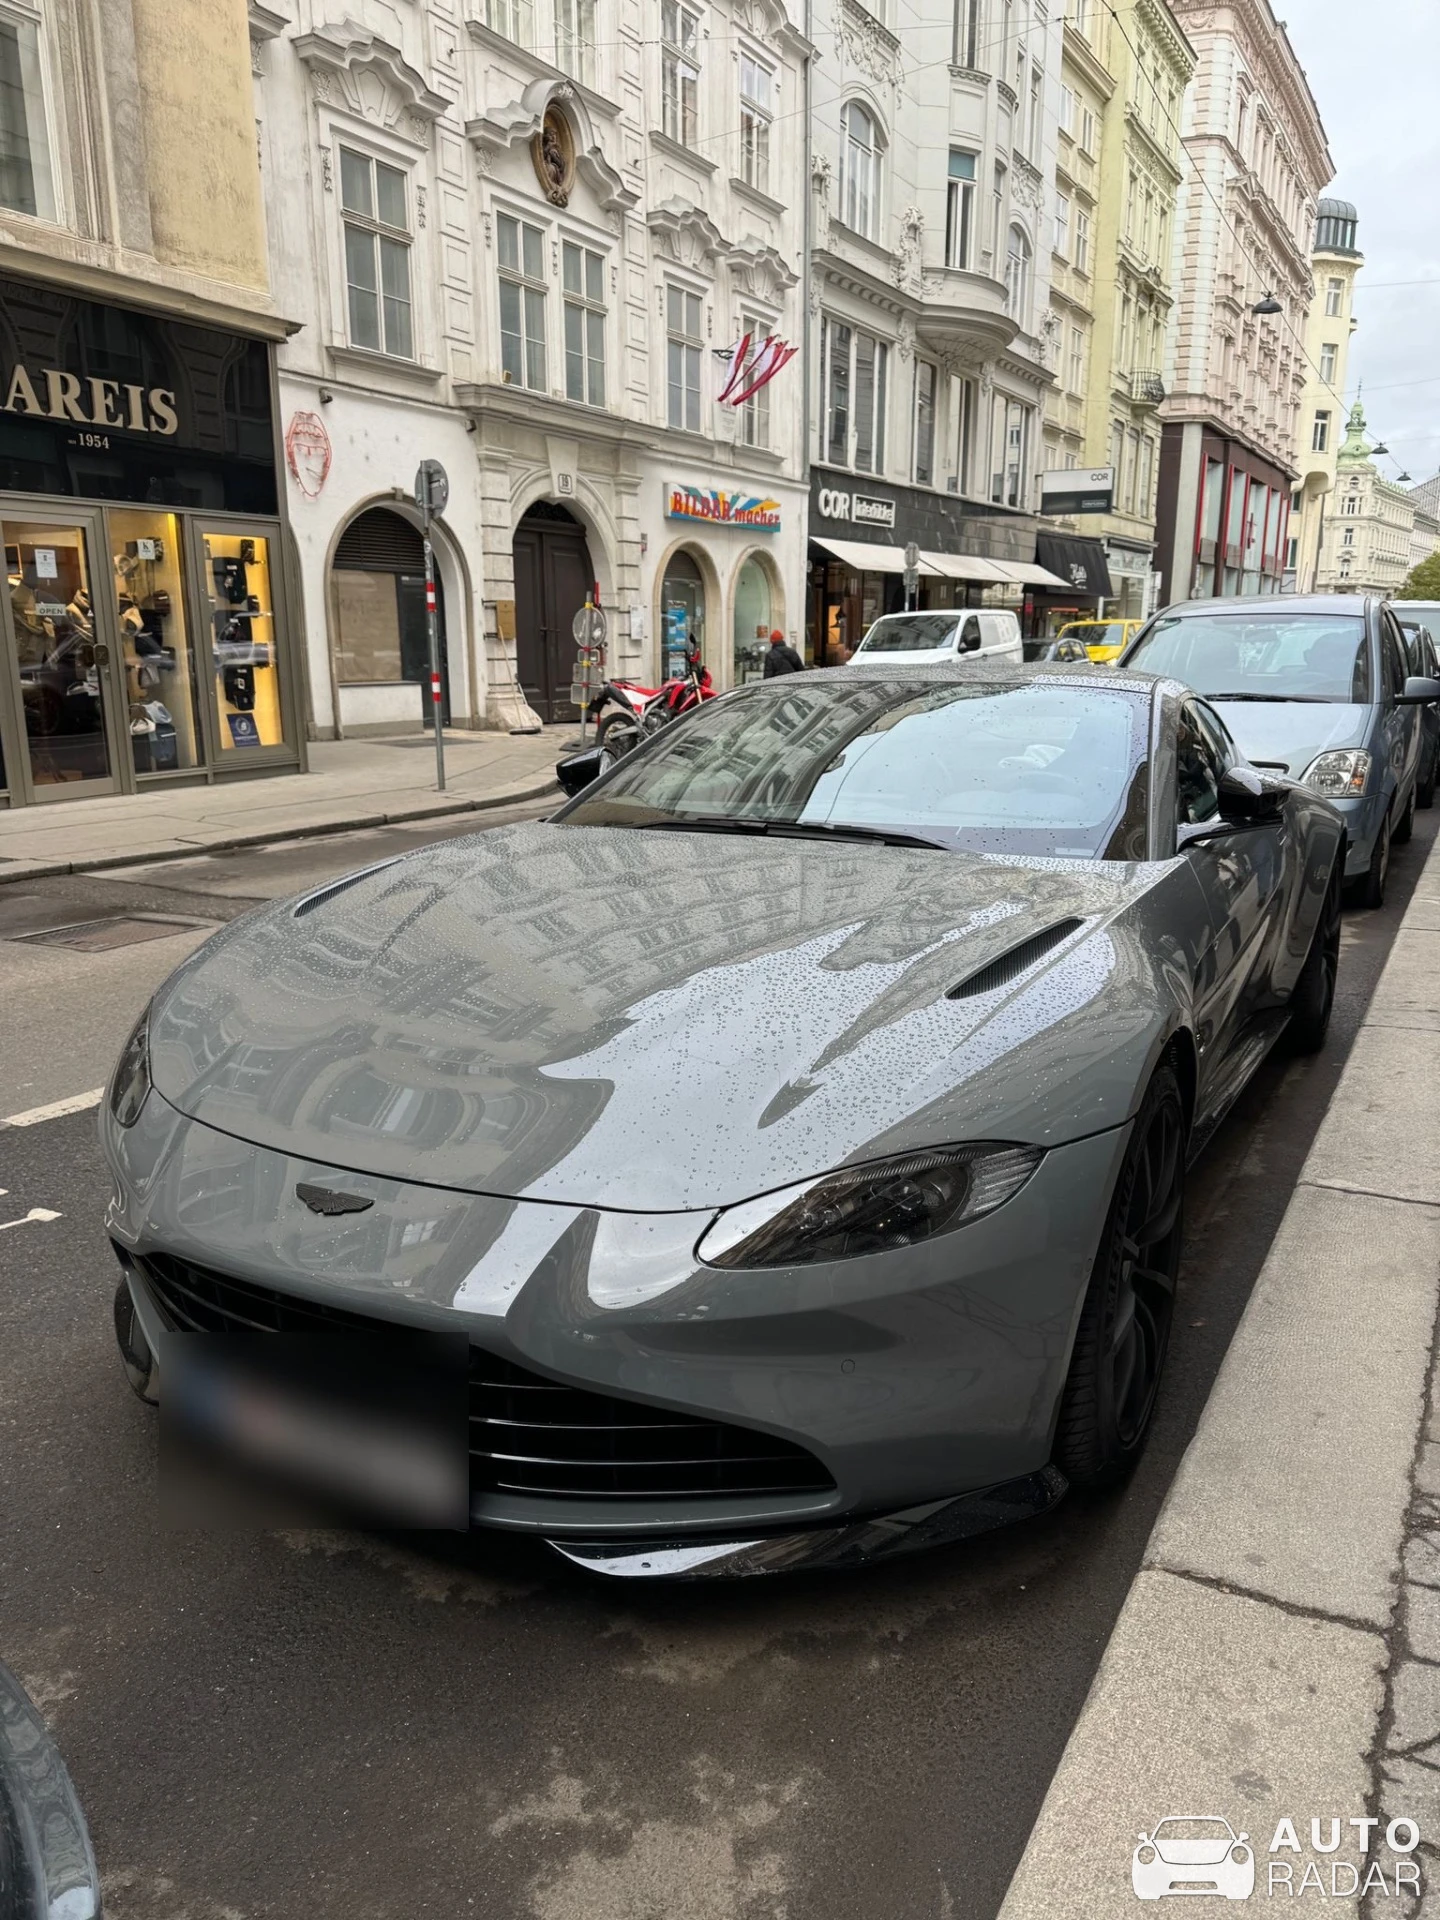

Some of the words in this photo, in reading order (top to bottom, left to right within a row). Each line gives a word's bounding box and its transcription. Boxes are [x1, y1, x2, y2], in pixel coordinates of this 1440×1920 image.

[0, 364, 178, 435] AREIS
[78, 433, 110, 449] 1954
[1091, 473, 1108, 481] COR
[673, 491, 731, 521] BILDER
[734, 507, 780, 527] macher
[819, 489, 850, 520] COR
